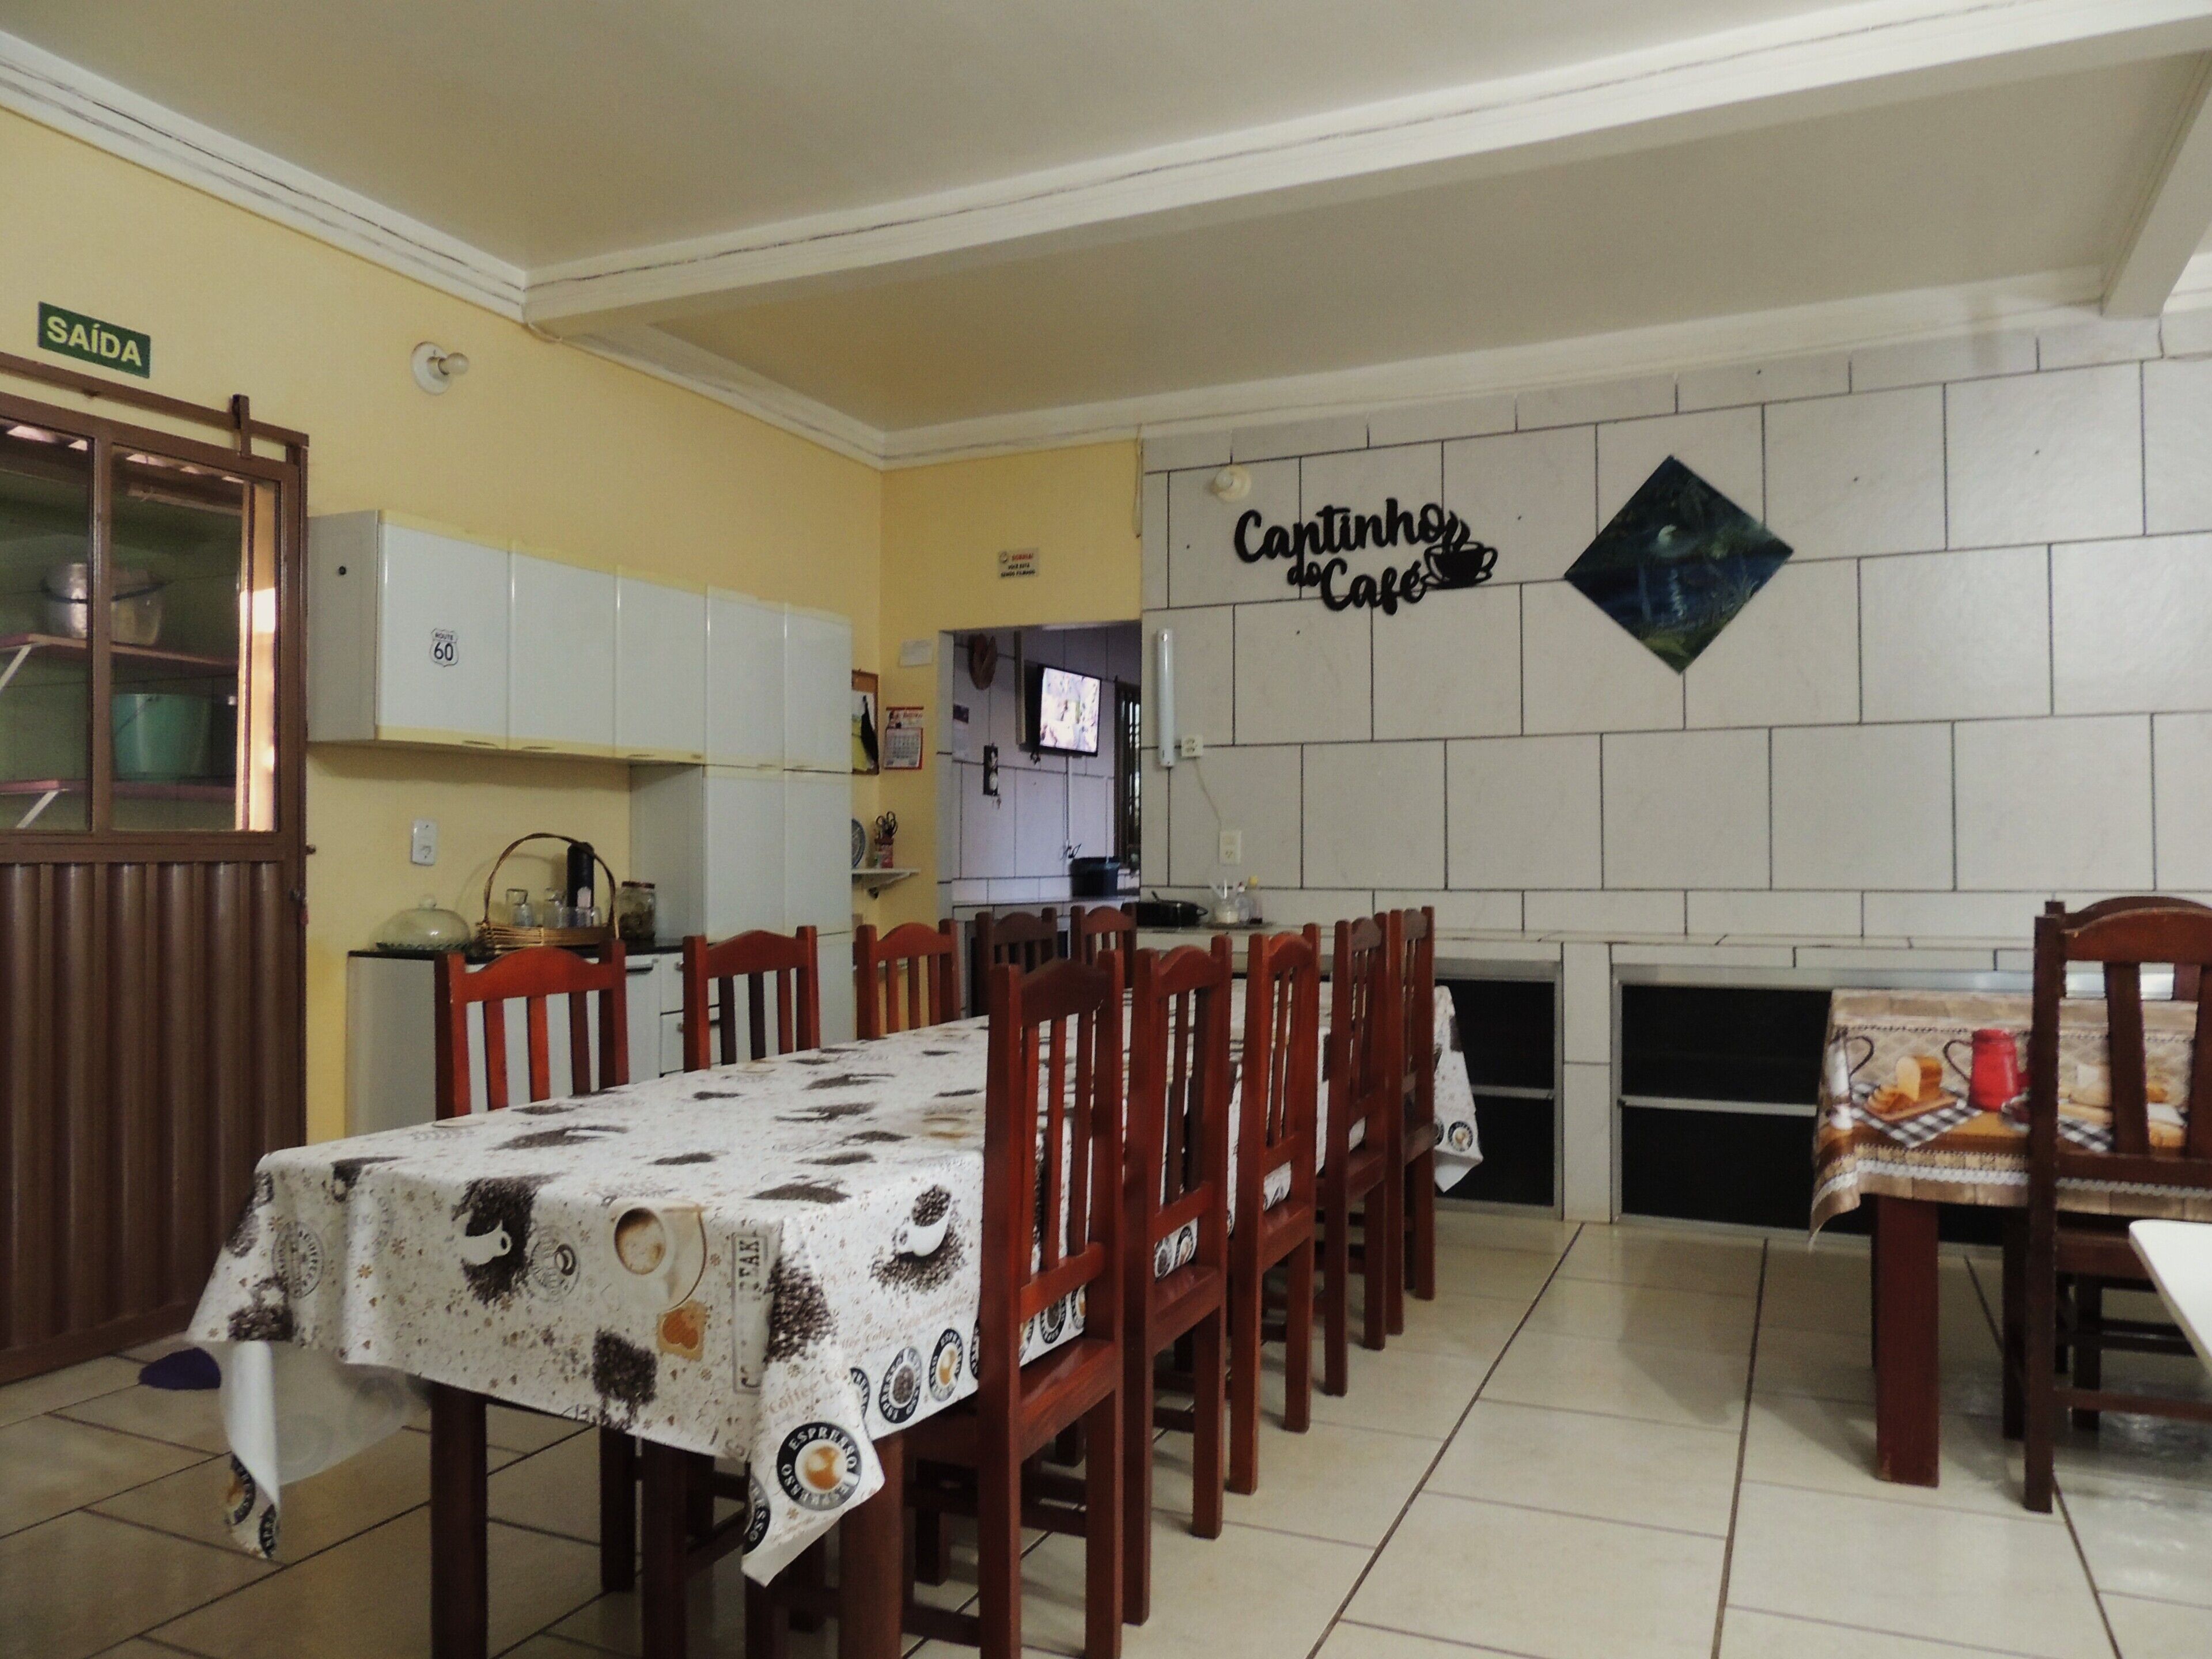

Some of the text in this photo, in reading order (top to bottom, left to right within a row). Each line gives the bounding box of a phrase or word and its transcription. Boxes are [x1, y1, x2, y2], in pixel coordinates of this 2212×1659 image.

[47, 316, 142, 367] SAÍDA
[1234, 497, 1446, 563] Cantinho
[1287, 557, 1429, 615] do Café
[434, 641, 453, 661] 60
